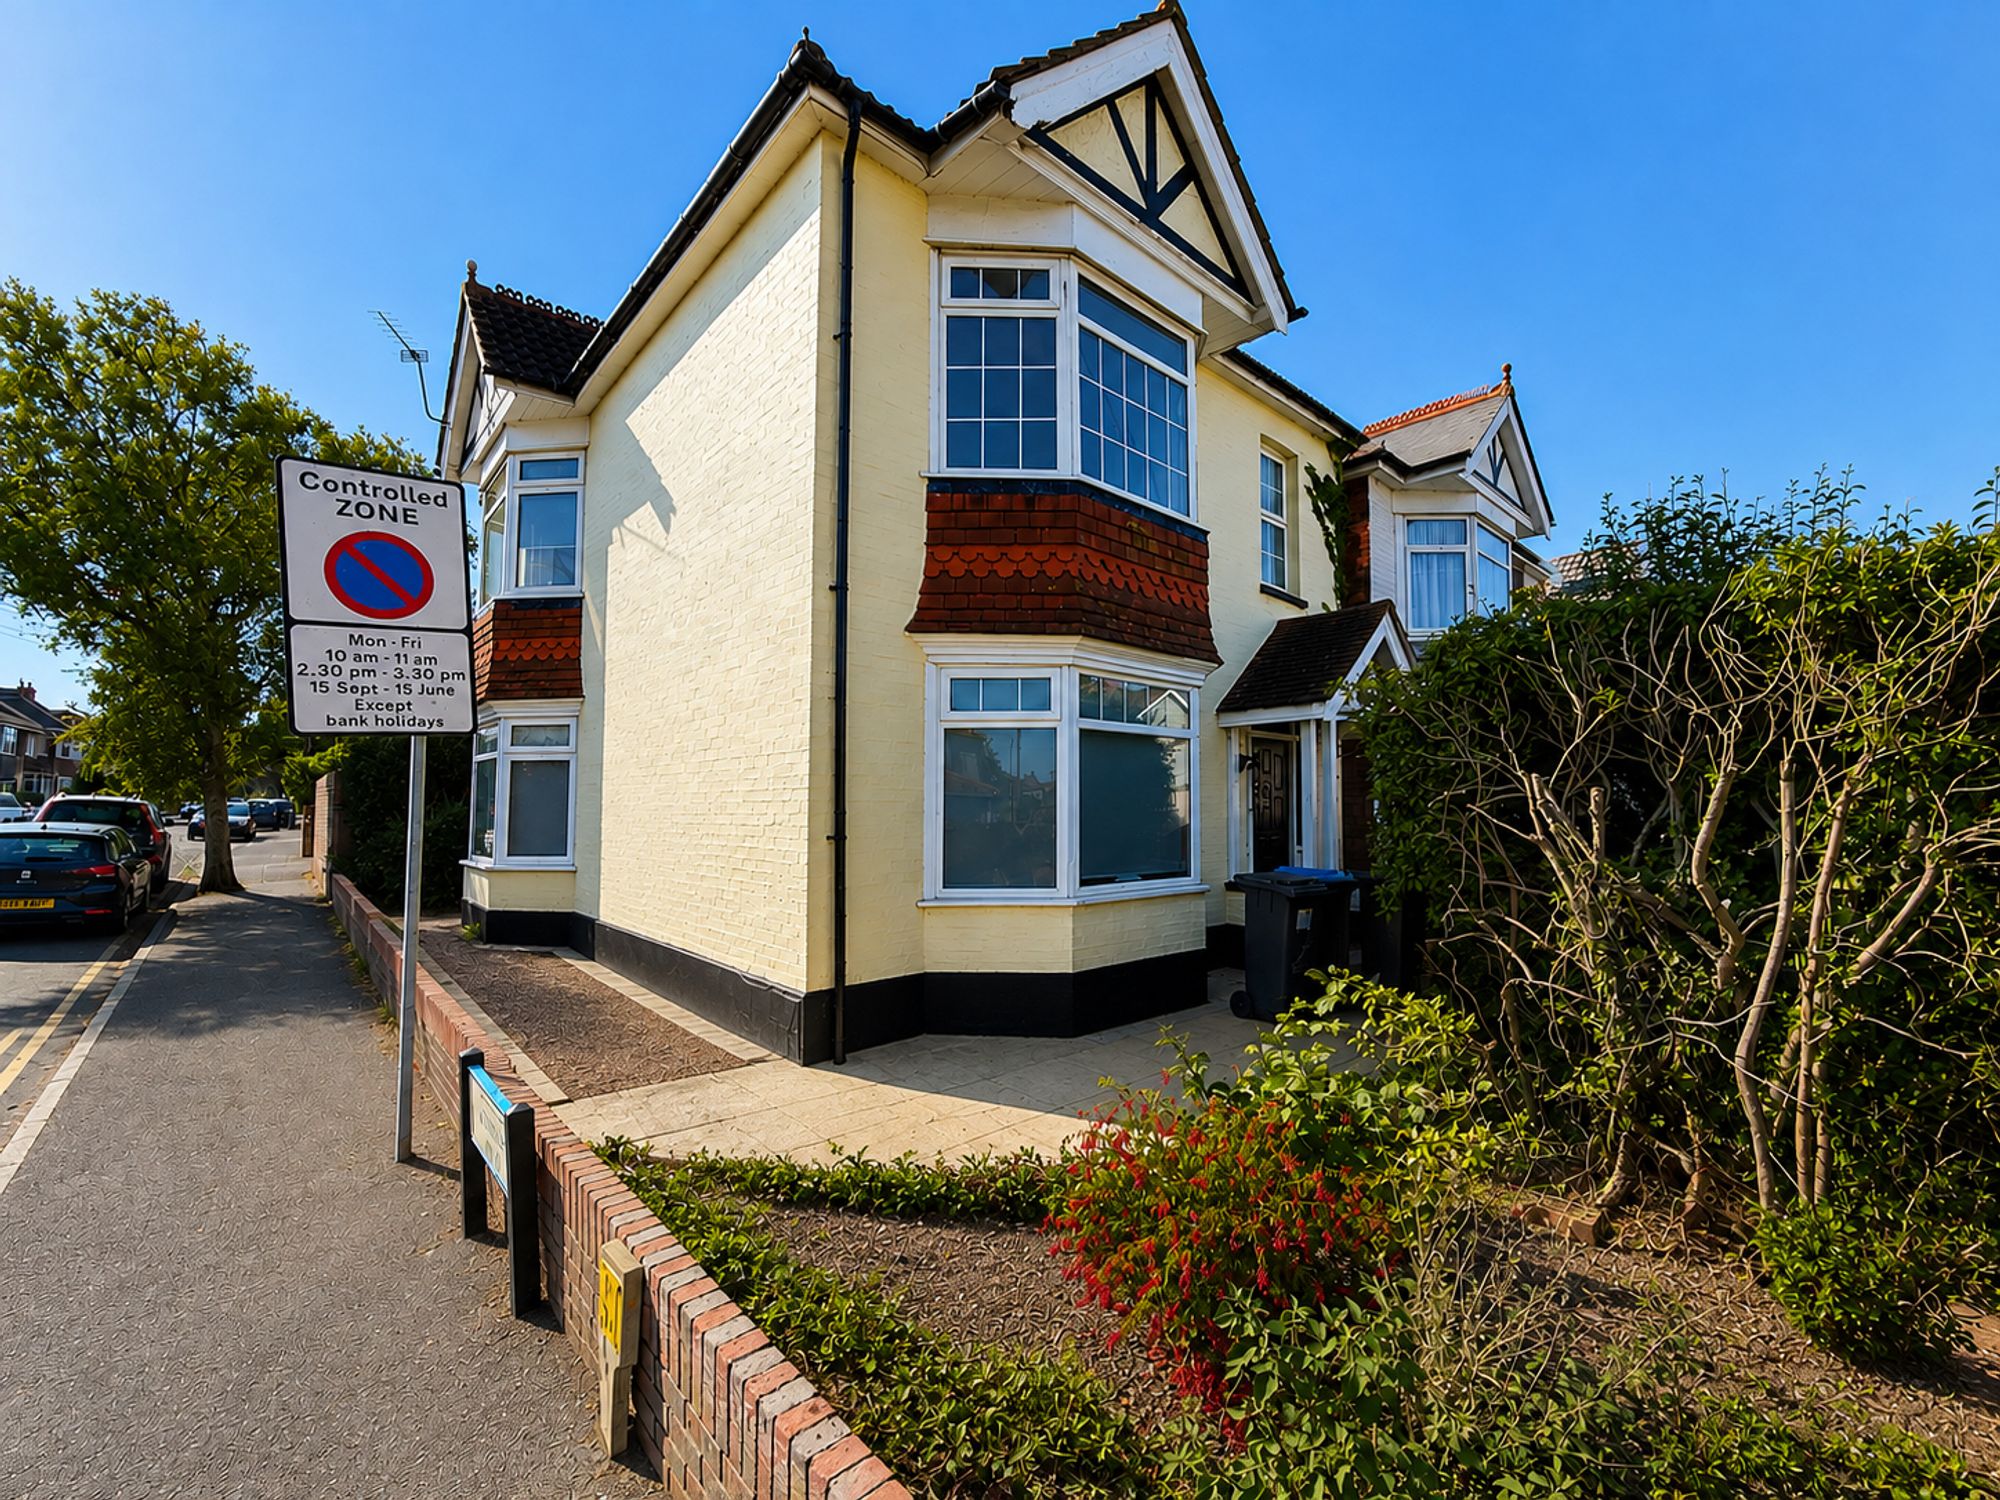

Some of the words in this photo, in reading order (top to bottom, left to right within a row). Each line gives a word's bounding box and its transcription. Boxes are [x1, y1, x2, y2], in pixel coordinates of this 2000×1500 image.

[299, 472, 448, 508] Controlled
[336, 499, 419, 525] ZONE
[348, 634, 387, 648] Mon
[401, 636, 421, 648] Fri
[326, 650, 347, 661] 10
[353, 653, 378, 663] am
[395, 653, 409, 664] 11
[414, 655, 438, 665] am
[297, 664, 343, 677] 2.30
[350, 668, 377, 680] pm
[393, 668, 434, 679] 3.30
[441, 670, 466, 683] pm
[310, 681, 330, 693] 15
[418, 685, 455, 696] June
[355, 699, 413, 713] Except
[326, 715, 369, 727] bank
[375, 716, 444, 729] holidays
